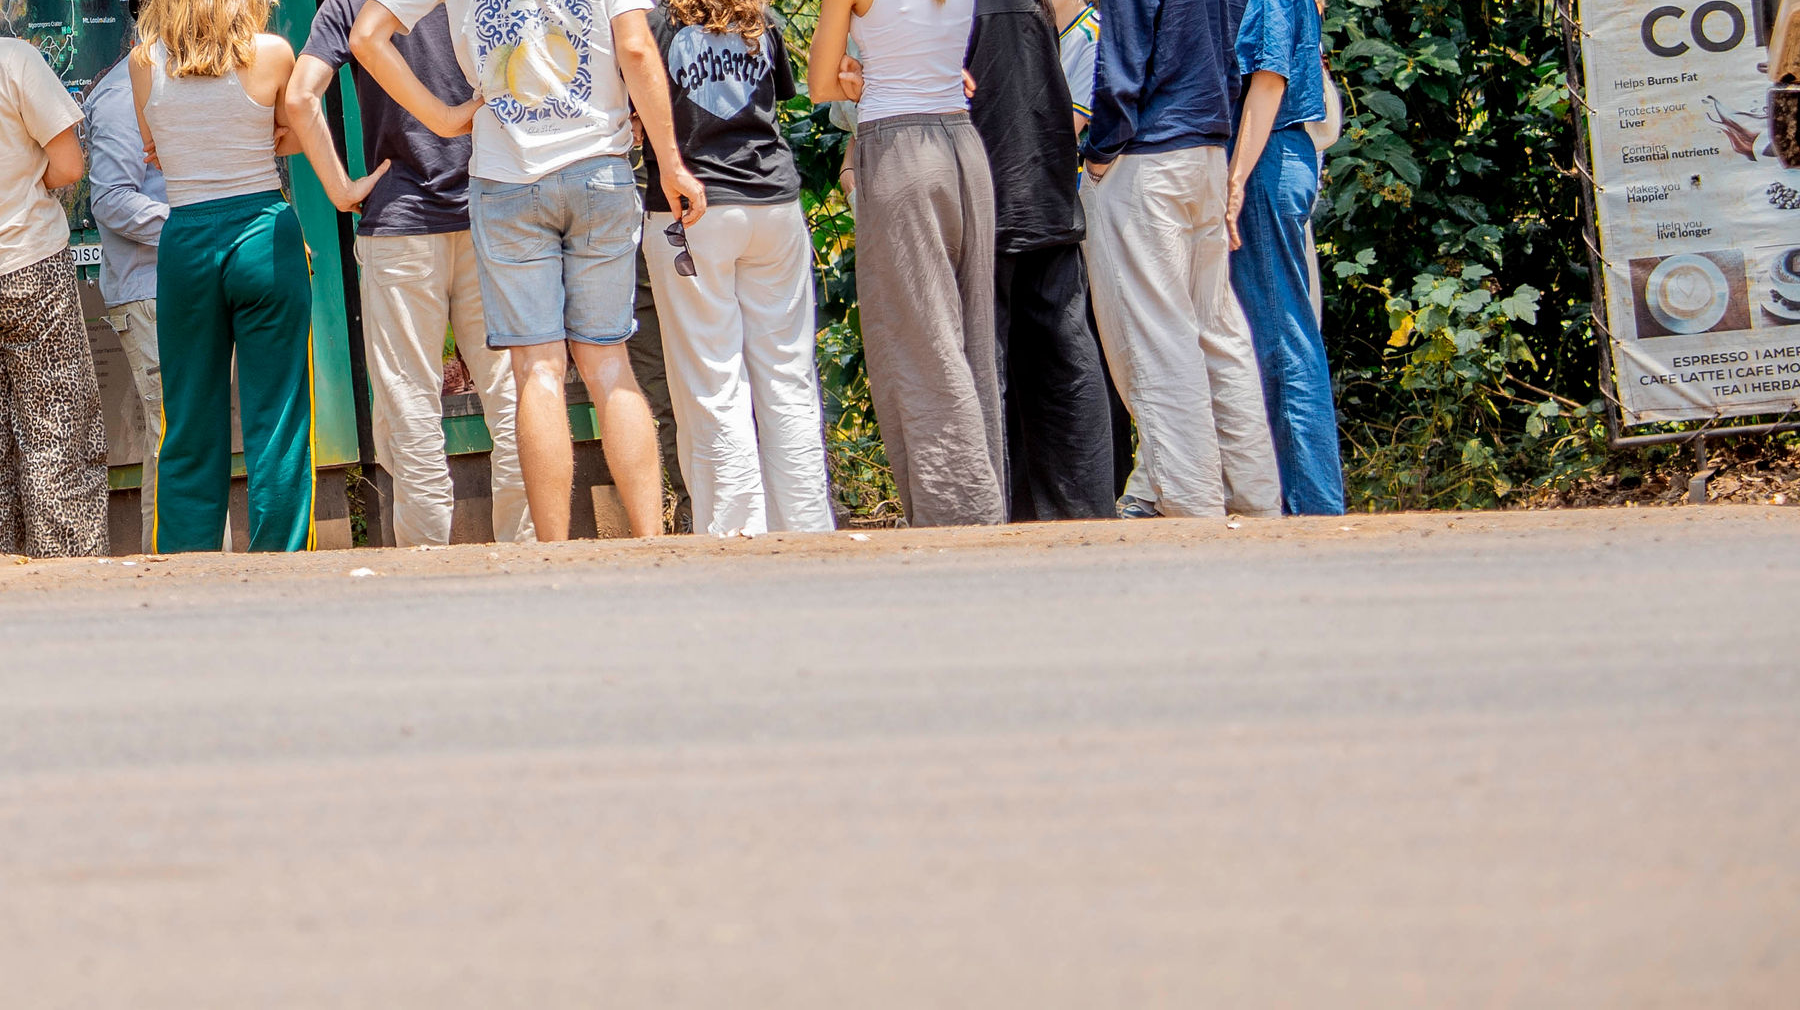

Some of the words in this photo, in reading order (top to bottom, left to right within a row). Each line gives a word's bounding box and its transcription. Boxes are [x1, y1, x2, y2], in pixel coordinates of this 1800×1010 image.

[1614, 79, 1645, 90] Helps
[1647, 76, 1678, 86] Burns
[1681, 72, 1698, 82] Fat
[1618, 105, 1661, 117] Protects
[1663, 103, 1687, 113] your
[1619, 119, 1645, 129] Liver
[1621, 144, 1667, 156] Contains
[1622, 152, 1669, 164] Essential
[1671, 146, 1720, 159] nutrients
[1626, 184, 1659, 195] Makes
[1661, 183, 1681, 193] you
[1627, 192, 1669, 204] Happier
[1656, 221, 1680, 232] Help
[1683, 220, 1702, 229] you
[1657, 229, 1676, 240] live
[1678, 227, 1712, 238] longer
[71, 247, 104, 261] DISC
[1673, 351, 1749, 368] ESPRESSO
[1640, 373, 1677, 386] CAFE
[1680, 369, 1725, 383] LATTE
[1735, 364, 1773, 379] CAFE
[1712, 384, 1741, 397] TEA
